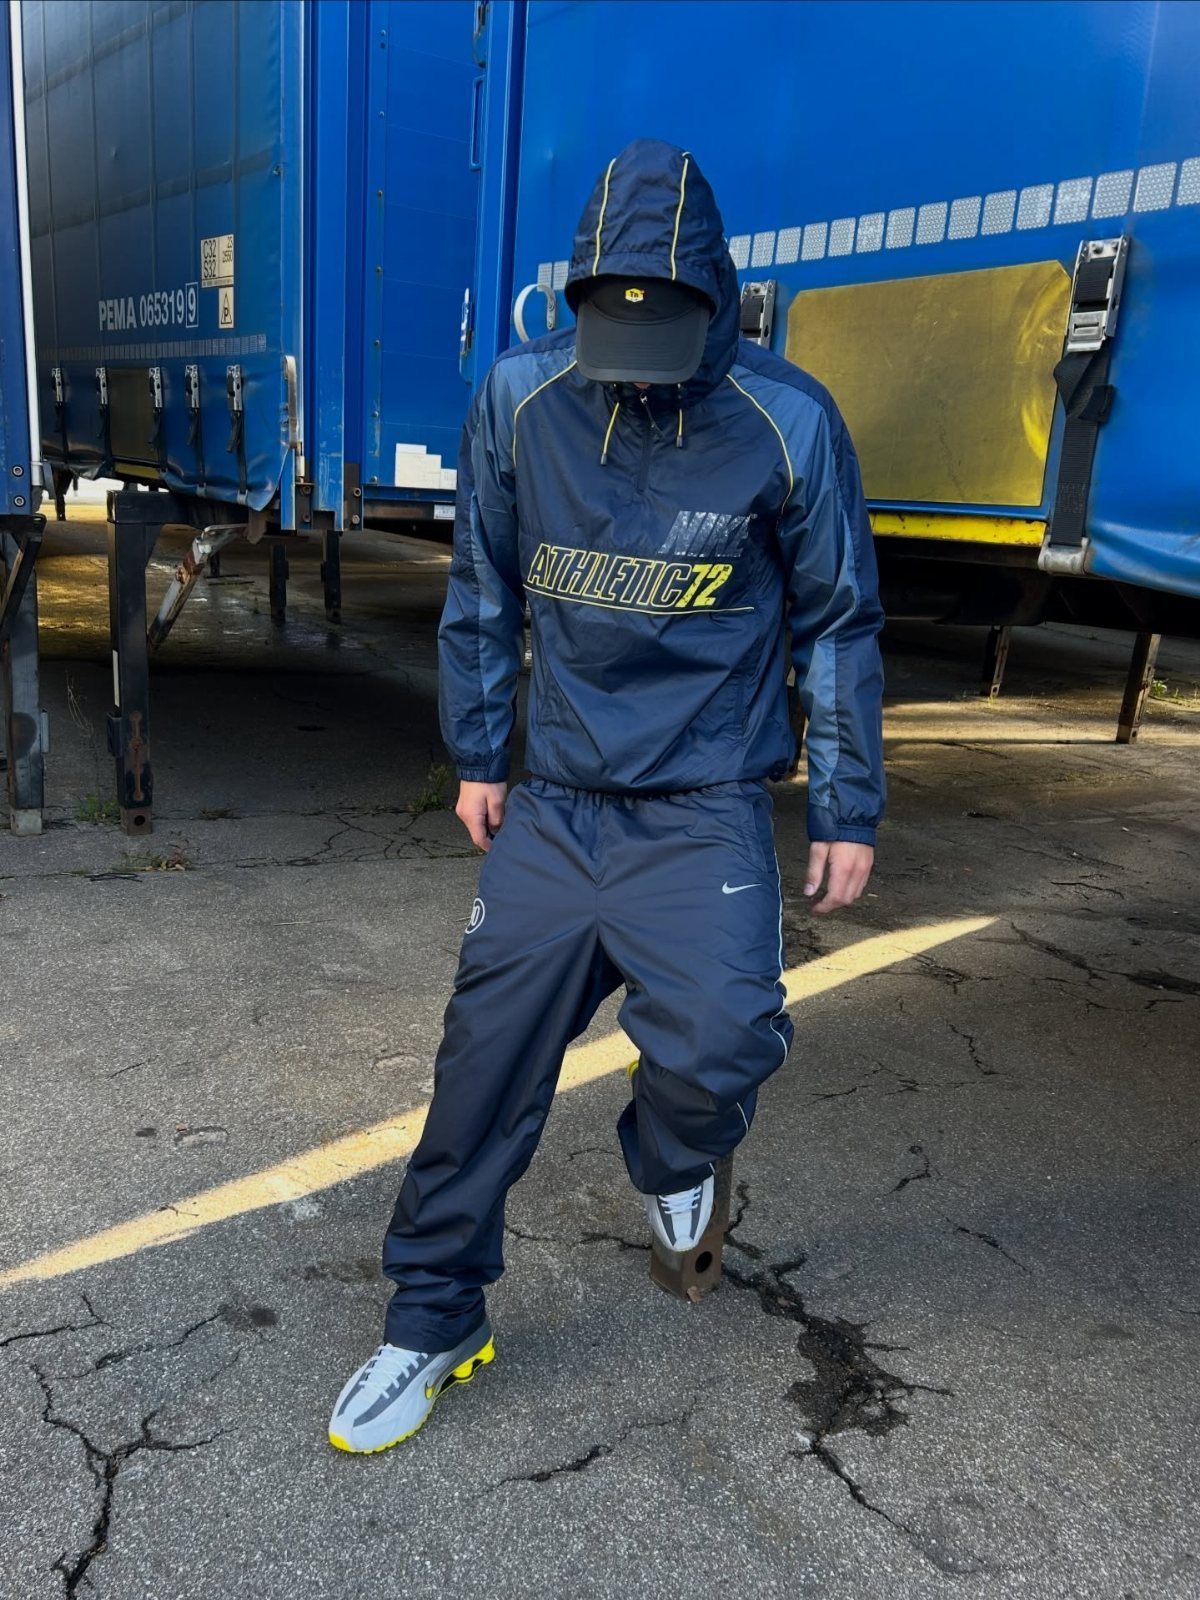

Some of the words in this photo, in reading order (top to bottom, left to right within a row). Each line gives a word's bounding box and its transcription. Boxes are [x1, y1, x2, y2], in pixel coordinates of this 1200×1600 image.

[203, 240, 216, 259] C32
[203, 259, 216, 278] S32
[98, 297, 137, 331] PEMA
